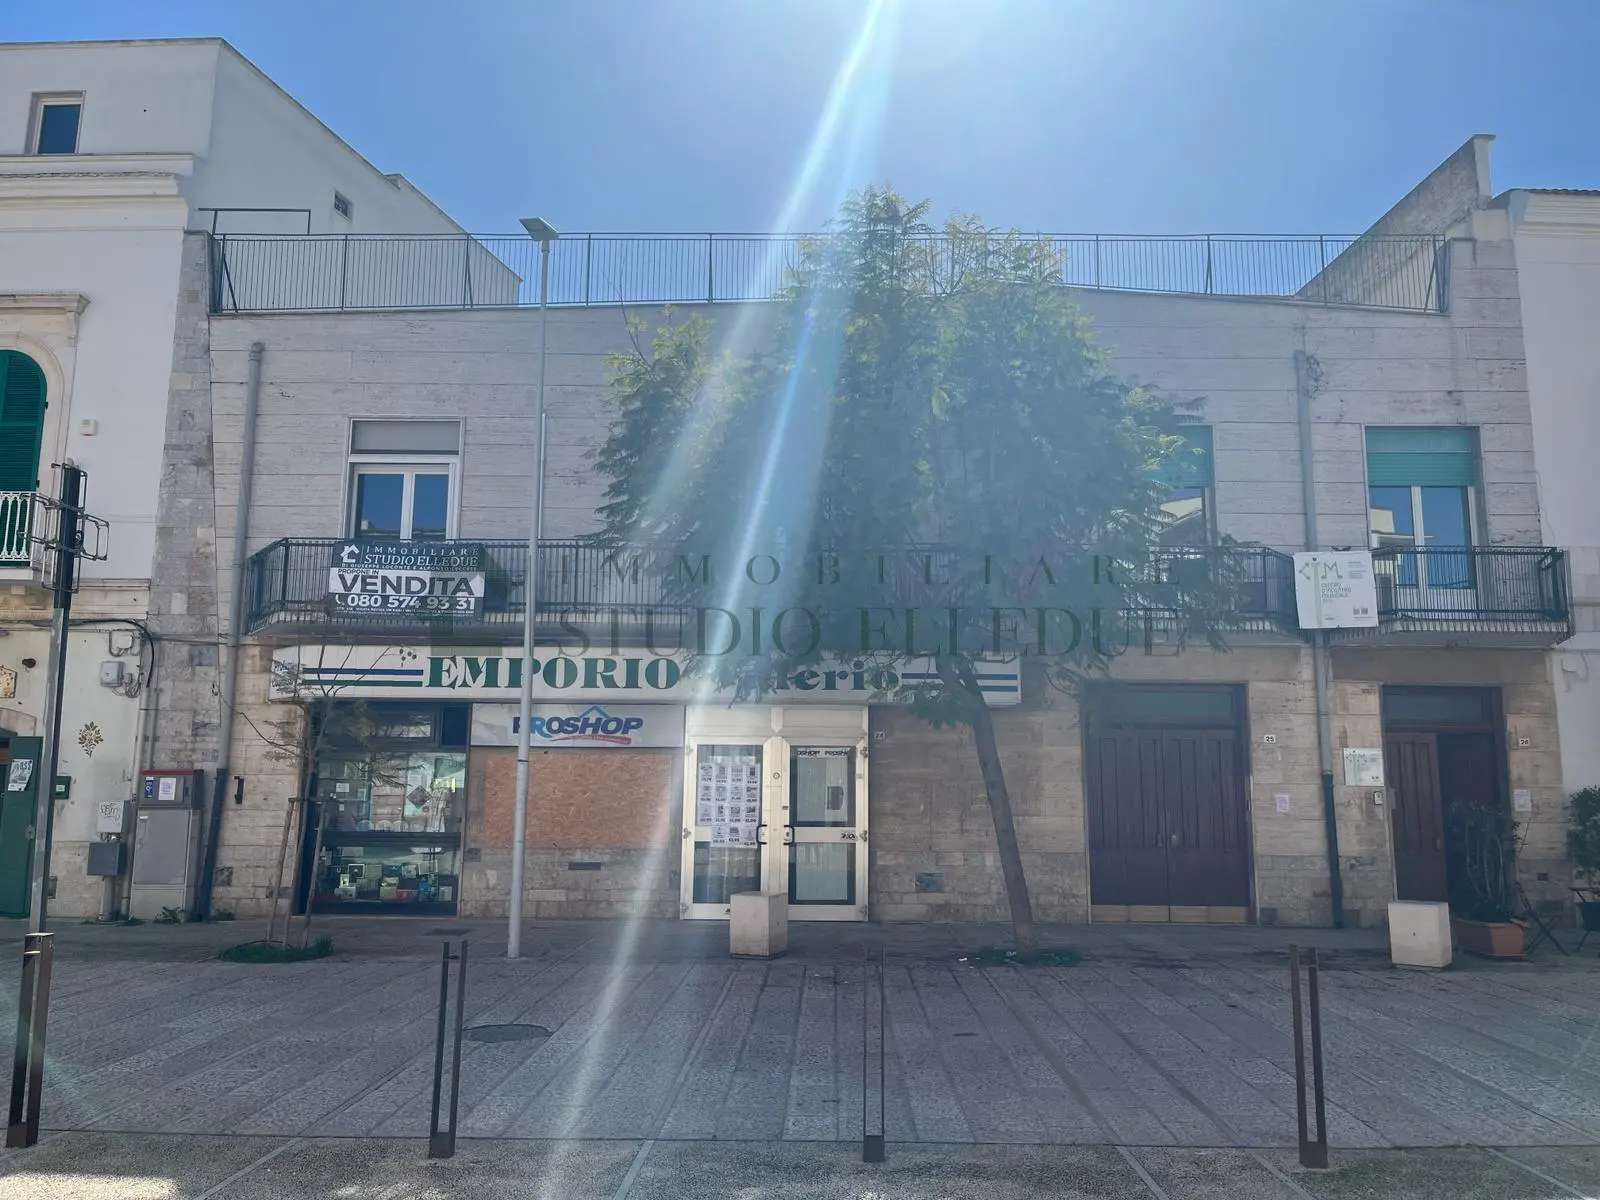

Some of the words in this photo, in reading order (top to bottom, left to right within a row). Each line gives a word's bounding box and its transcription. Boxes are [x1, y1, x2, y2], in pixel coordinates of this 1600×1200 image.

[366, 546, 479, 556] IMMOBILIARE
[364, 554, 414, 566] STUDIO
[416, 556, 478, 567] ELLEDUE
[337, 574, 475, 596] VENDITA
[347, 595, 382, 607] 080
[387, 596, 421, 608] 574
[426, 597, 450, 610] 93
[455, 598, 475, 610] 31
[425, 654, 681, 690] EMPORIO
